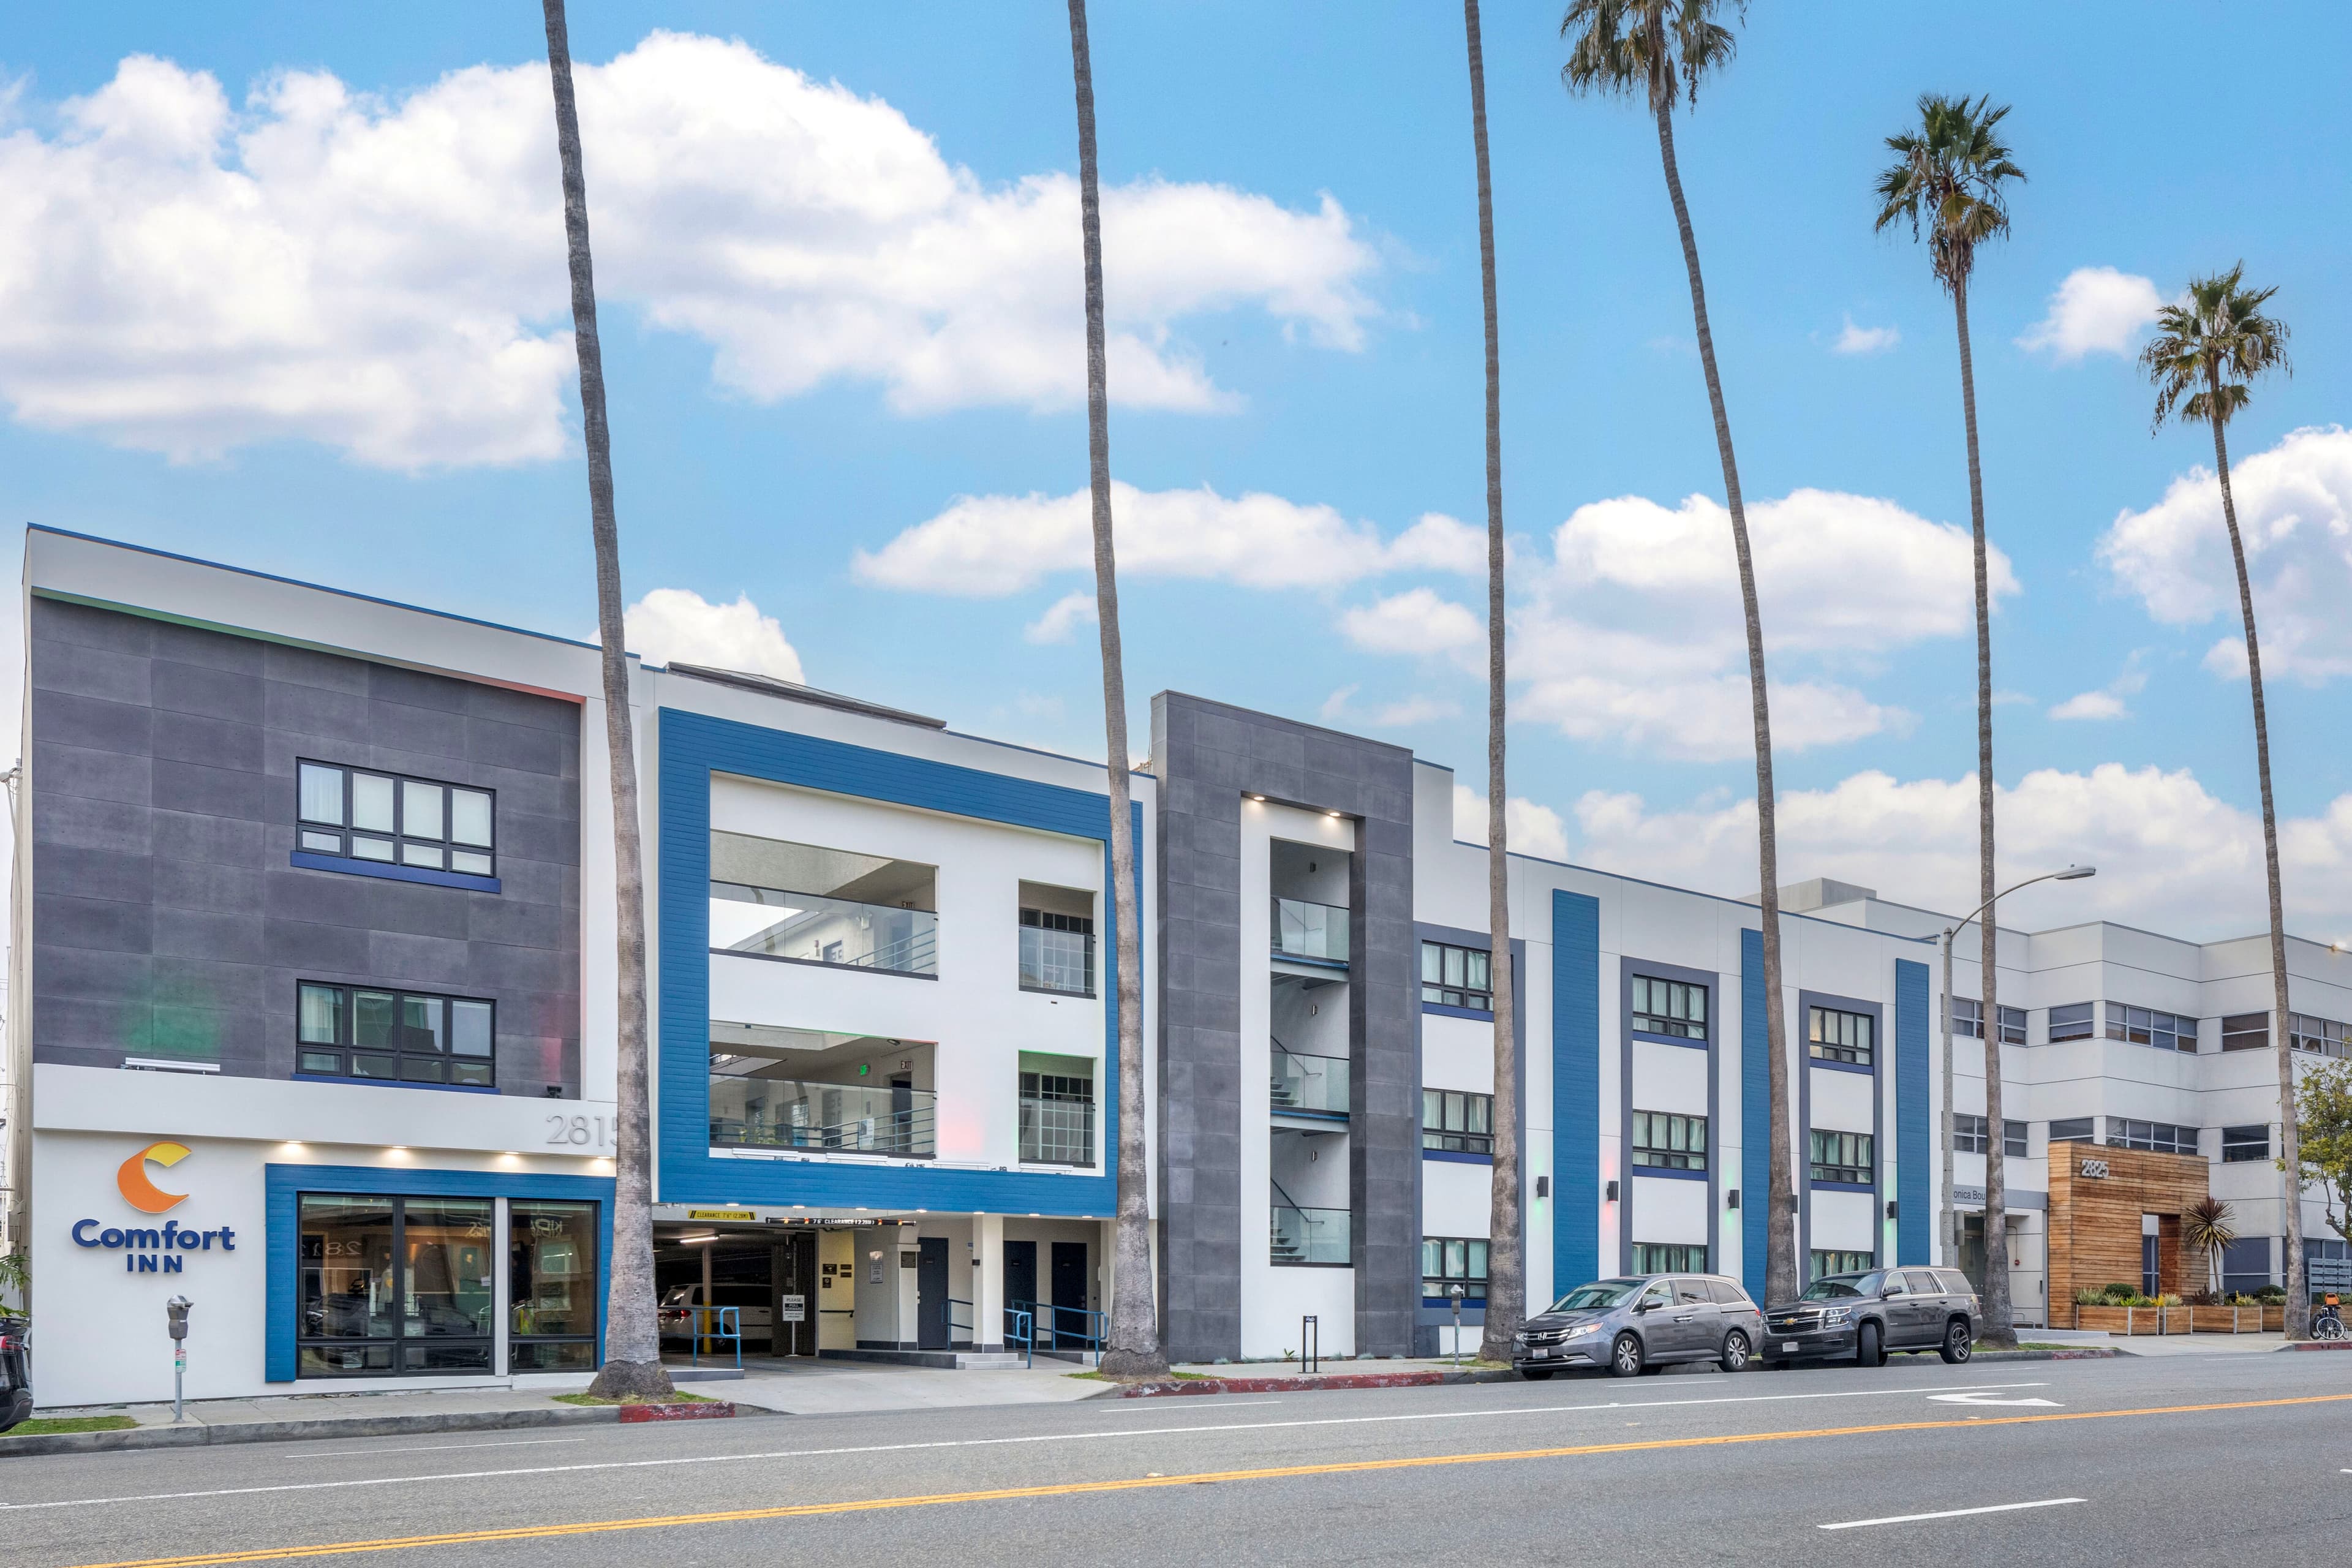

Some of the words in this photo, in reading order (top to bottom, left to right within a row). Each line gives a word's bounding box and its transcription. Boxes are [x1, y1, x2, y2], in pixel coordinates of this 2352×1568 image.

[901, 1061, 911, 1069] EXIT
[2081, 1159, 2109, 1178] 2825
[1953, 1189, 1971, 1199] onica
[72, 1219, 235, 1250] Comfort
[127, 1254, 182, 1273] INN
